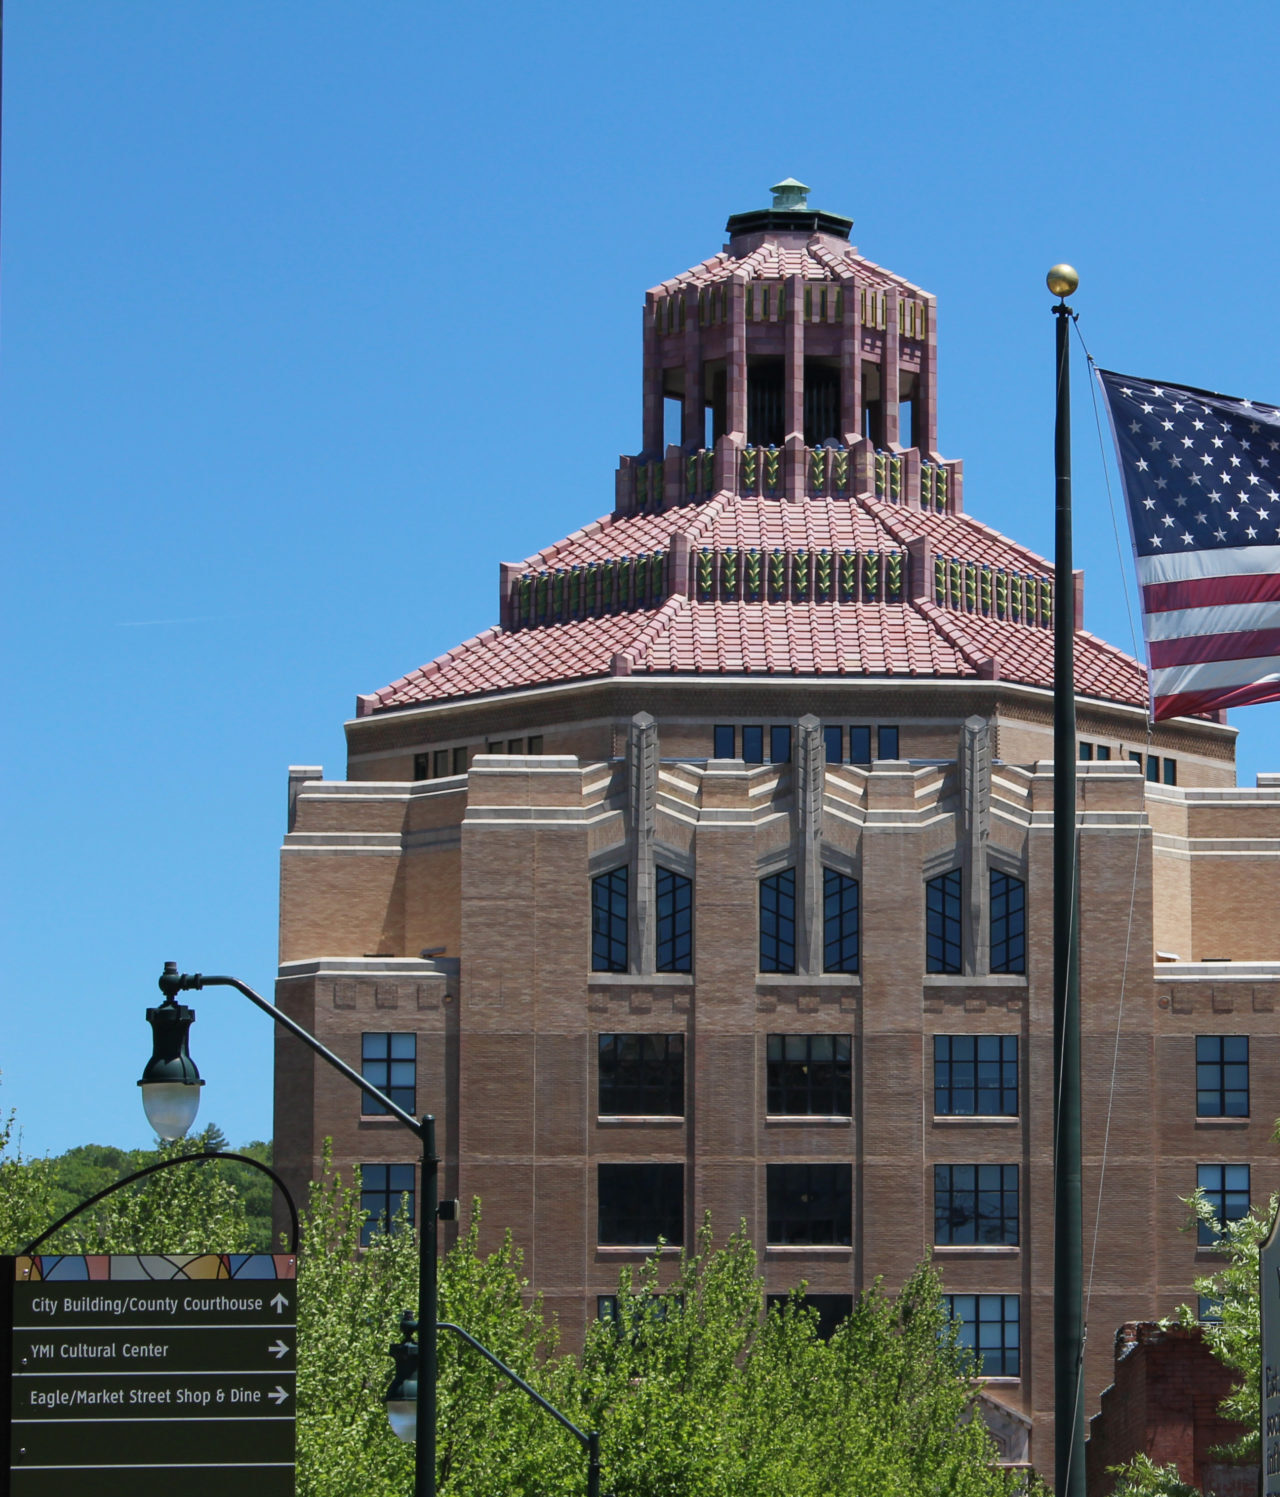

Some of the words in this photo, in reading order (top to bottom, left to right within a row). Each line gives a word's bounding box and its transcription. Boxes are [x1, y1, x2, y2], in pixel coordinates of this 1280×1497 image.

[32, 1297, 57, 1315] City
[64, 1297, 178, 1314] Building/County
[184, 1296, 262, 1310] Courthouse
[31, 1345, 53, 1358] YMI
[61, 1343, 115, 1357] Cultural
[123, 1344, 168, 1357] Center
[31, 1389, 124, 1408] Eagle/Market
[130, 1389, 170, 1403] Street
[177, 1389, 210, 1406] Shop
[216, 1389, 225, 1402] &
[231, 1388, 261, 1402] Dine
